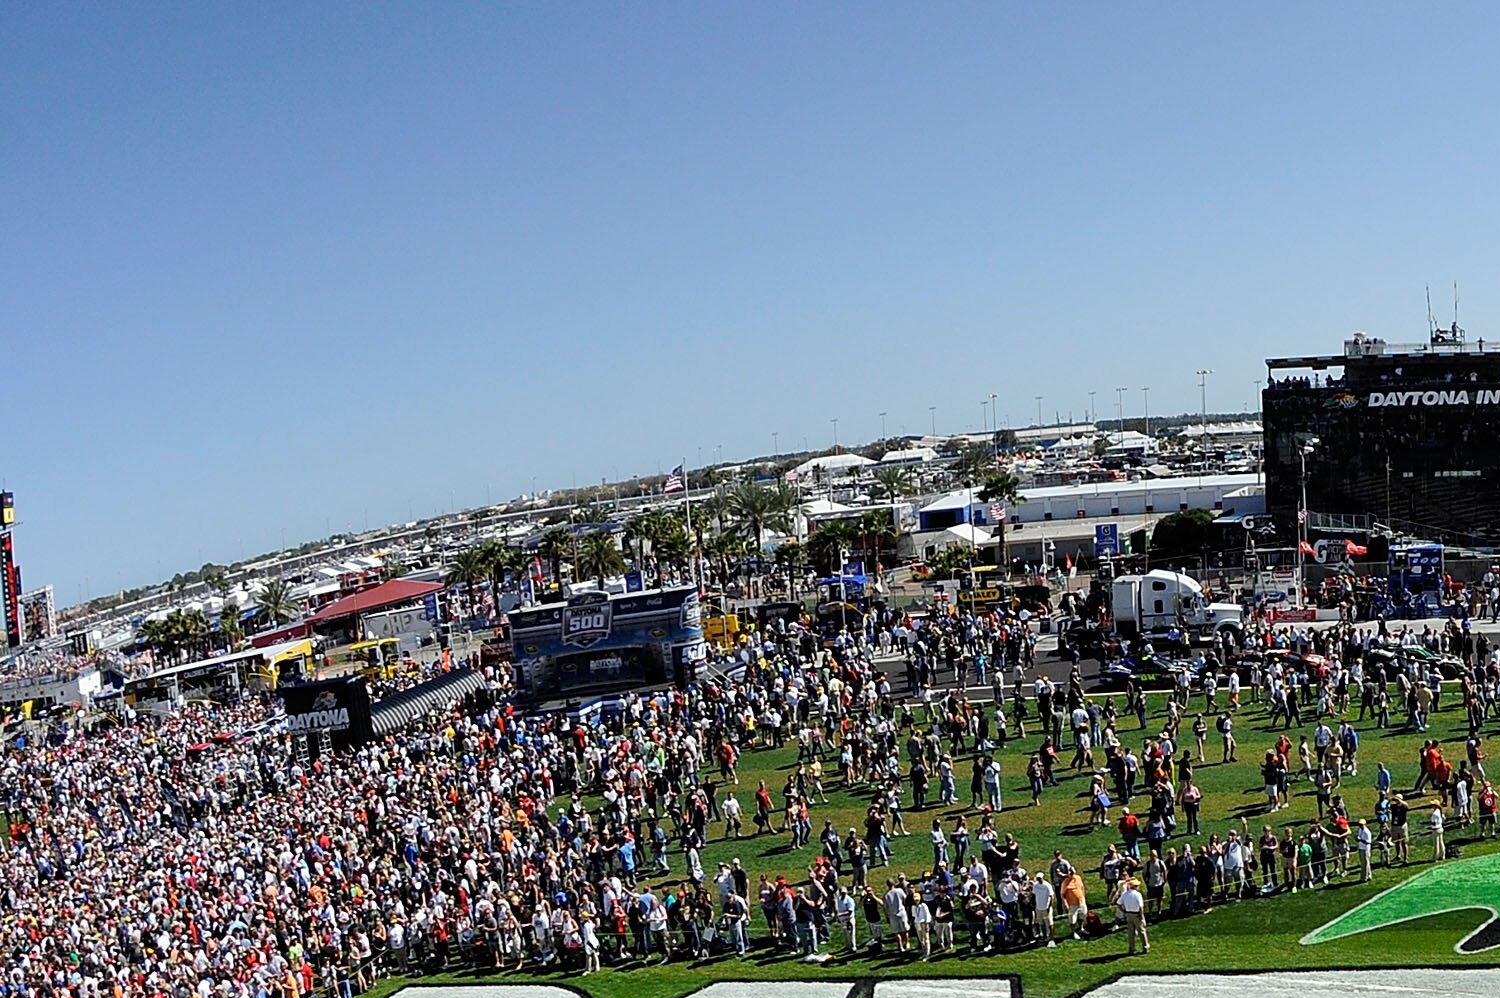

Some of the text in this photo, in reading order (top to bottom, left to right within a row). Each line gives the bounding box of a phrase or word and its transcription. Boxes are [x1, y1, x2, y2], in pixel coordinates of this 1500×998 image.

[1368, 390, 1470, 407] DAYTONA
[1242, 515, 1255, 530] G
[1313, 539, 1328, 564] G
[571, 606, 602, 617] DAYTONA
[569, 614, 605, 632] 500
[287, 707, 350, 732] DAYTONA
